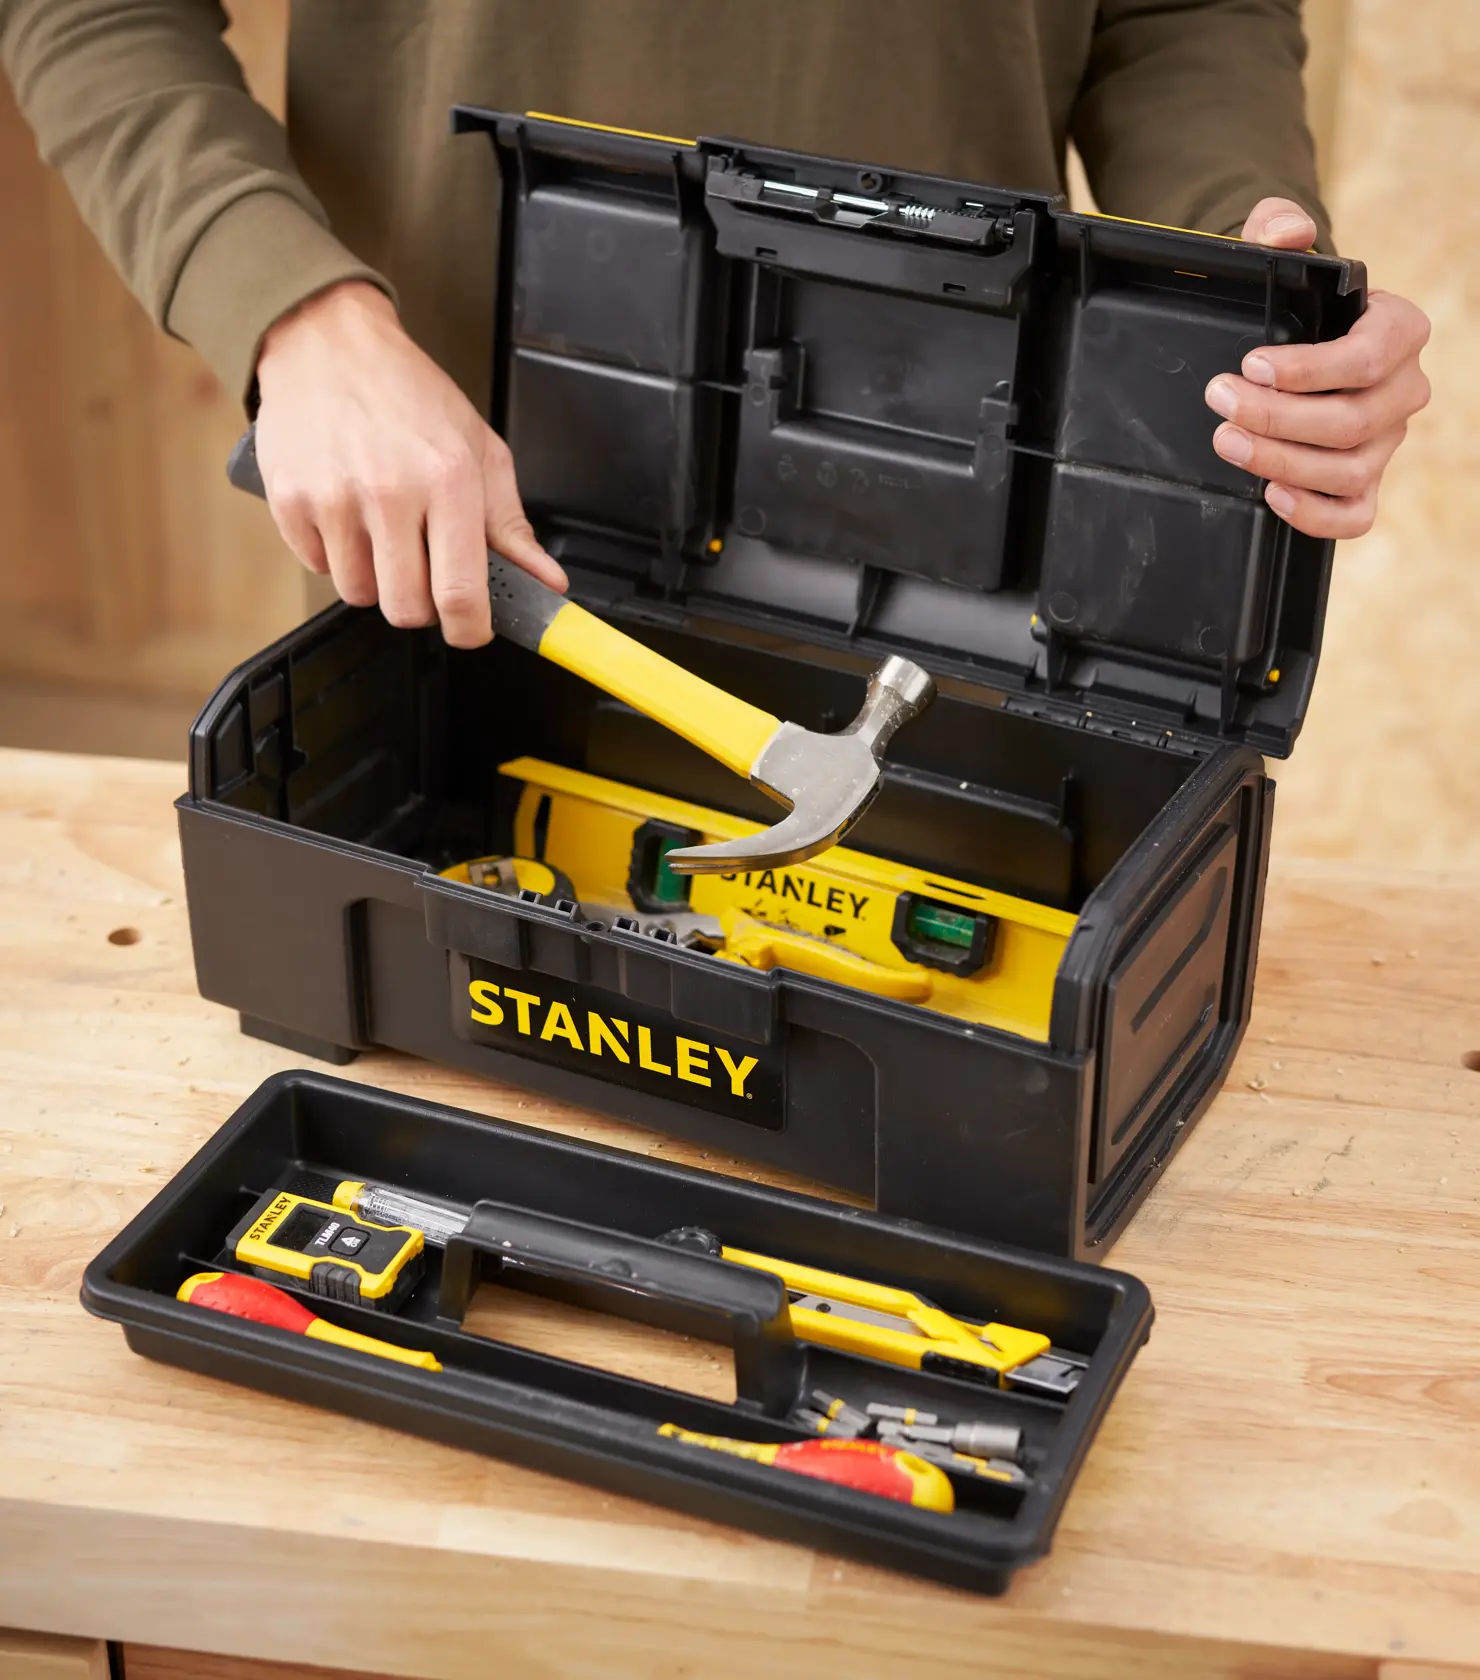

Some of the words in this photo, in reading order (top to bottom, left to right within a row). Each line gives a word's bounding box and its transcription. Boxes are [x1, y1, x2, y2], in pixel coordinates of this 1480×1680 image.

[469, 980, 759, 1098] STANLEY
[250, 1196, 292, 1240] STANLEY
[315, 1222, 341, 1246] TLM40
